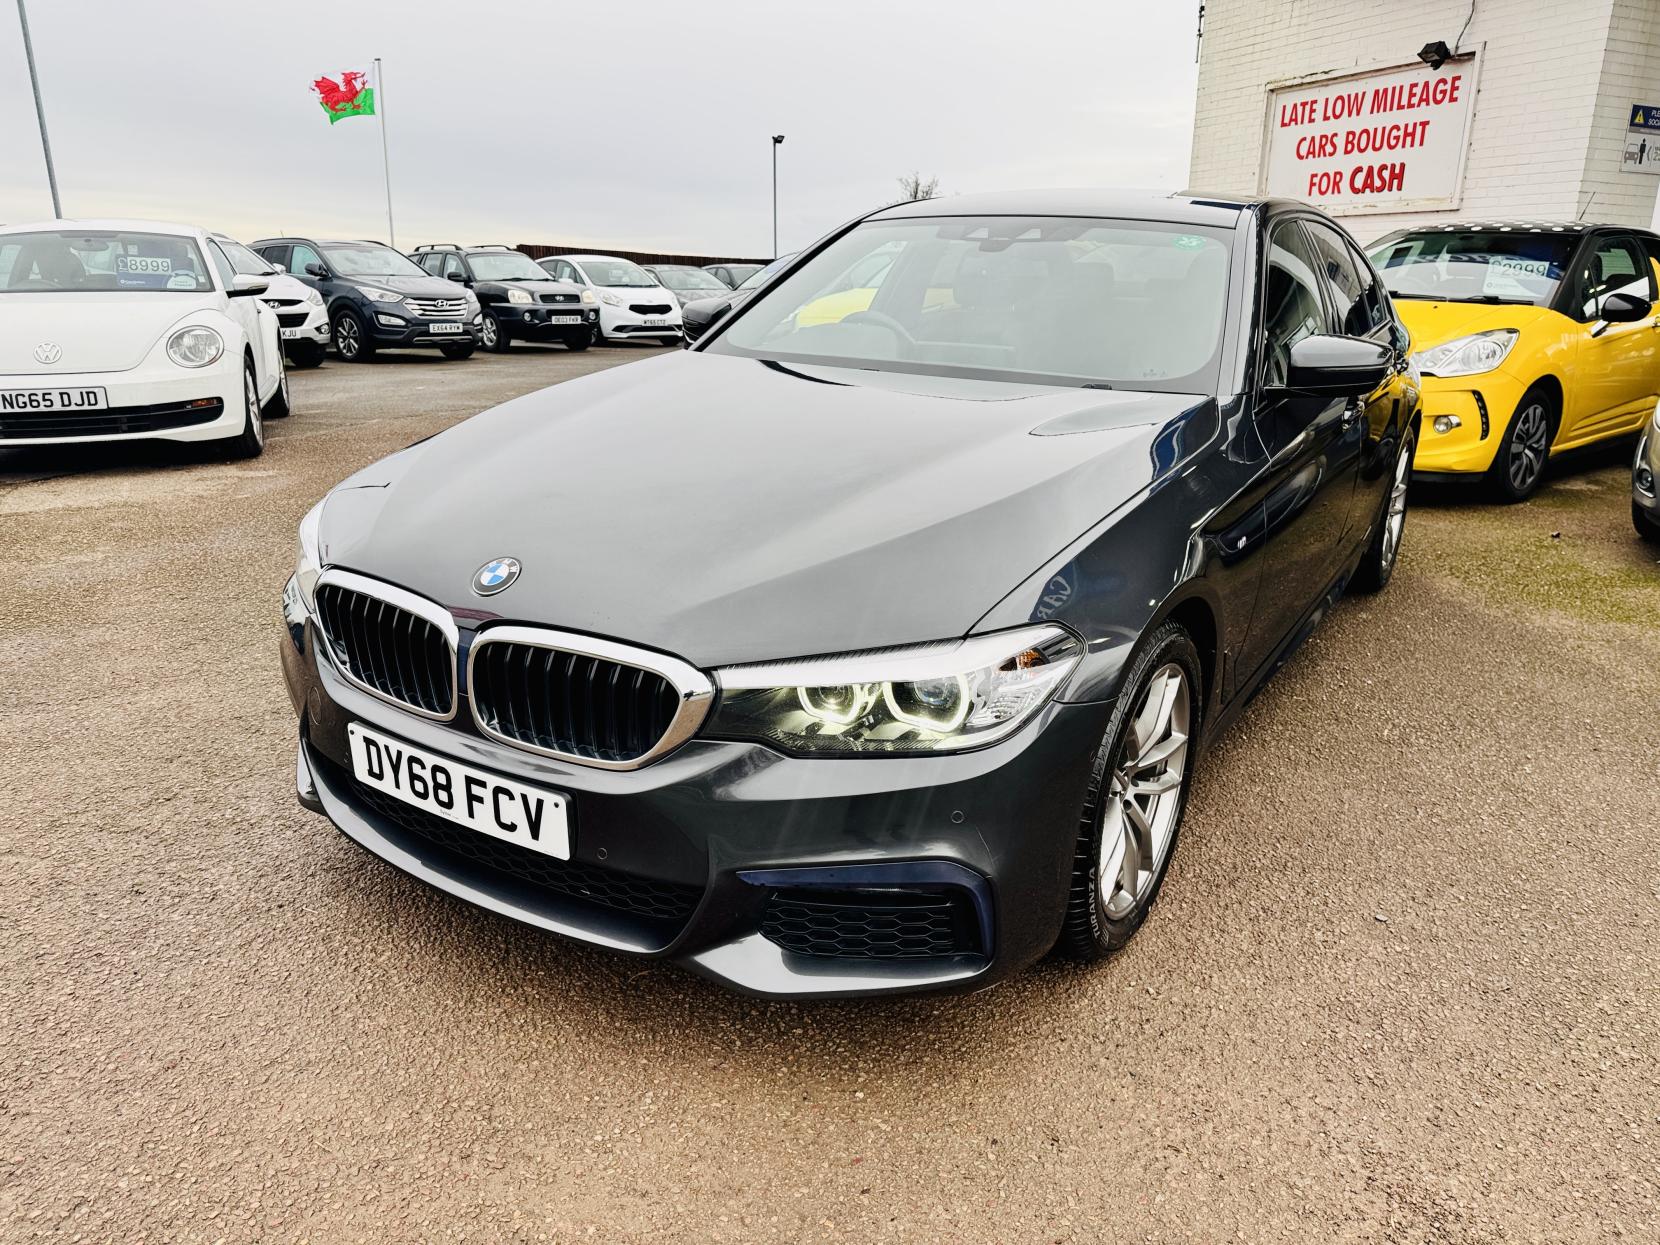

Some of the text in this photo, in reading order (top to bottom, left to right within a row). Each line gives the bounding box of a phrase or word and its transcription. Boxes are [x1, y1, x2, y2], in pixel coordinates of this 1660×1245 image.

[1280, 75, 1462, 128] LATE LOW MILEAGE
[1295, 120, 1431, 160] CARS BOUGHT
[1307, 162, 1406, 197] FOR CASH
[281, 329, 297, 338] KJU
[0, 390, 99, 410] NG65 DJD
[362, 735, 545, 842] DY68 FCV
[1088, 866, 1101, 940] TURANZA
